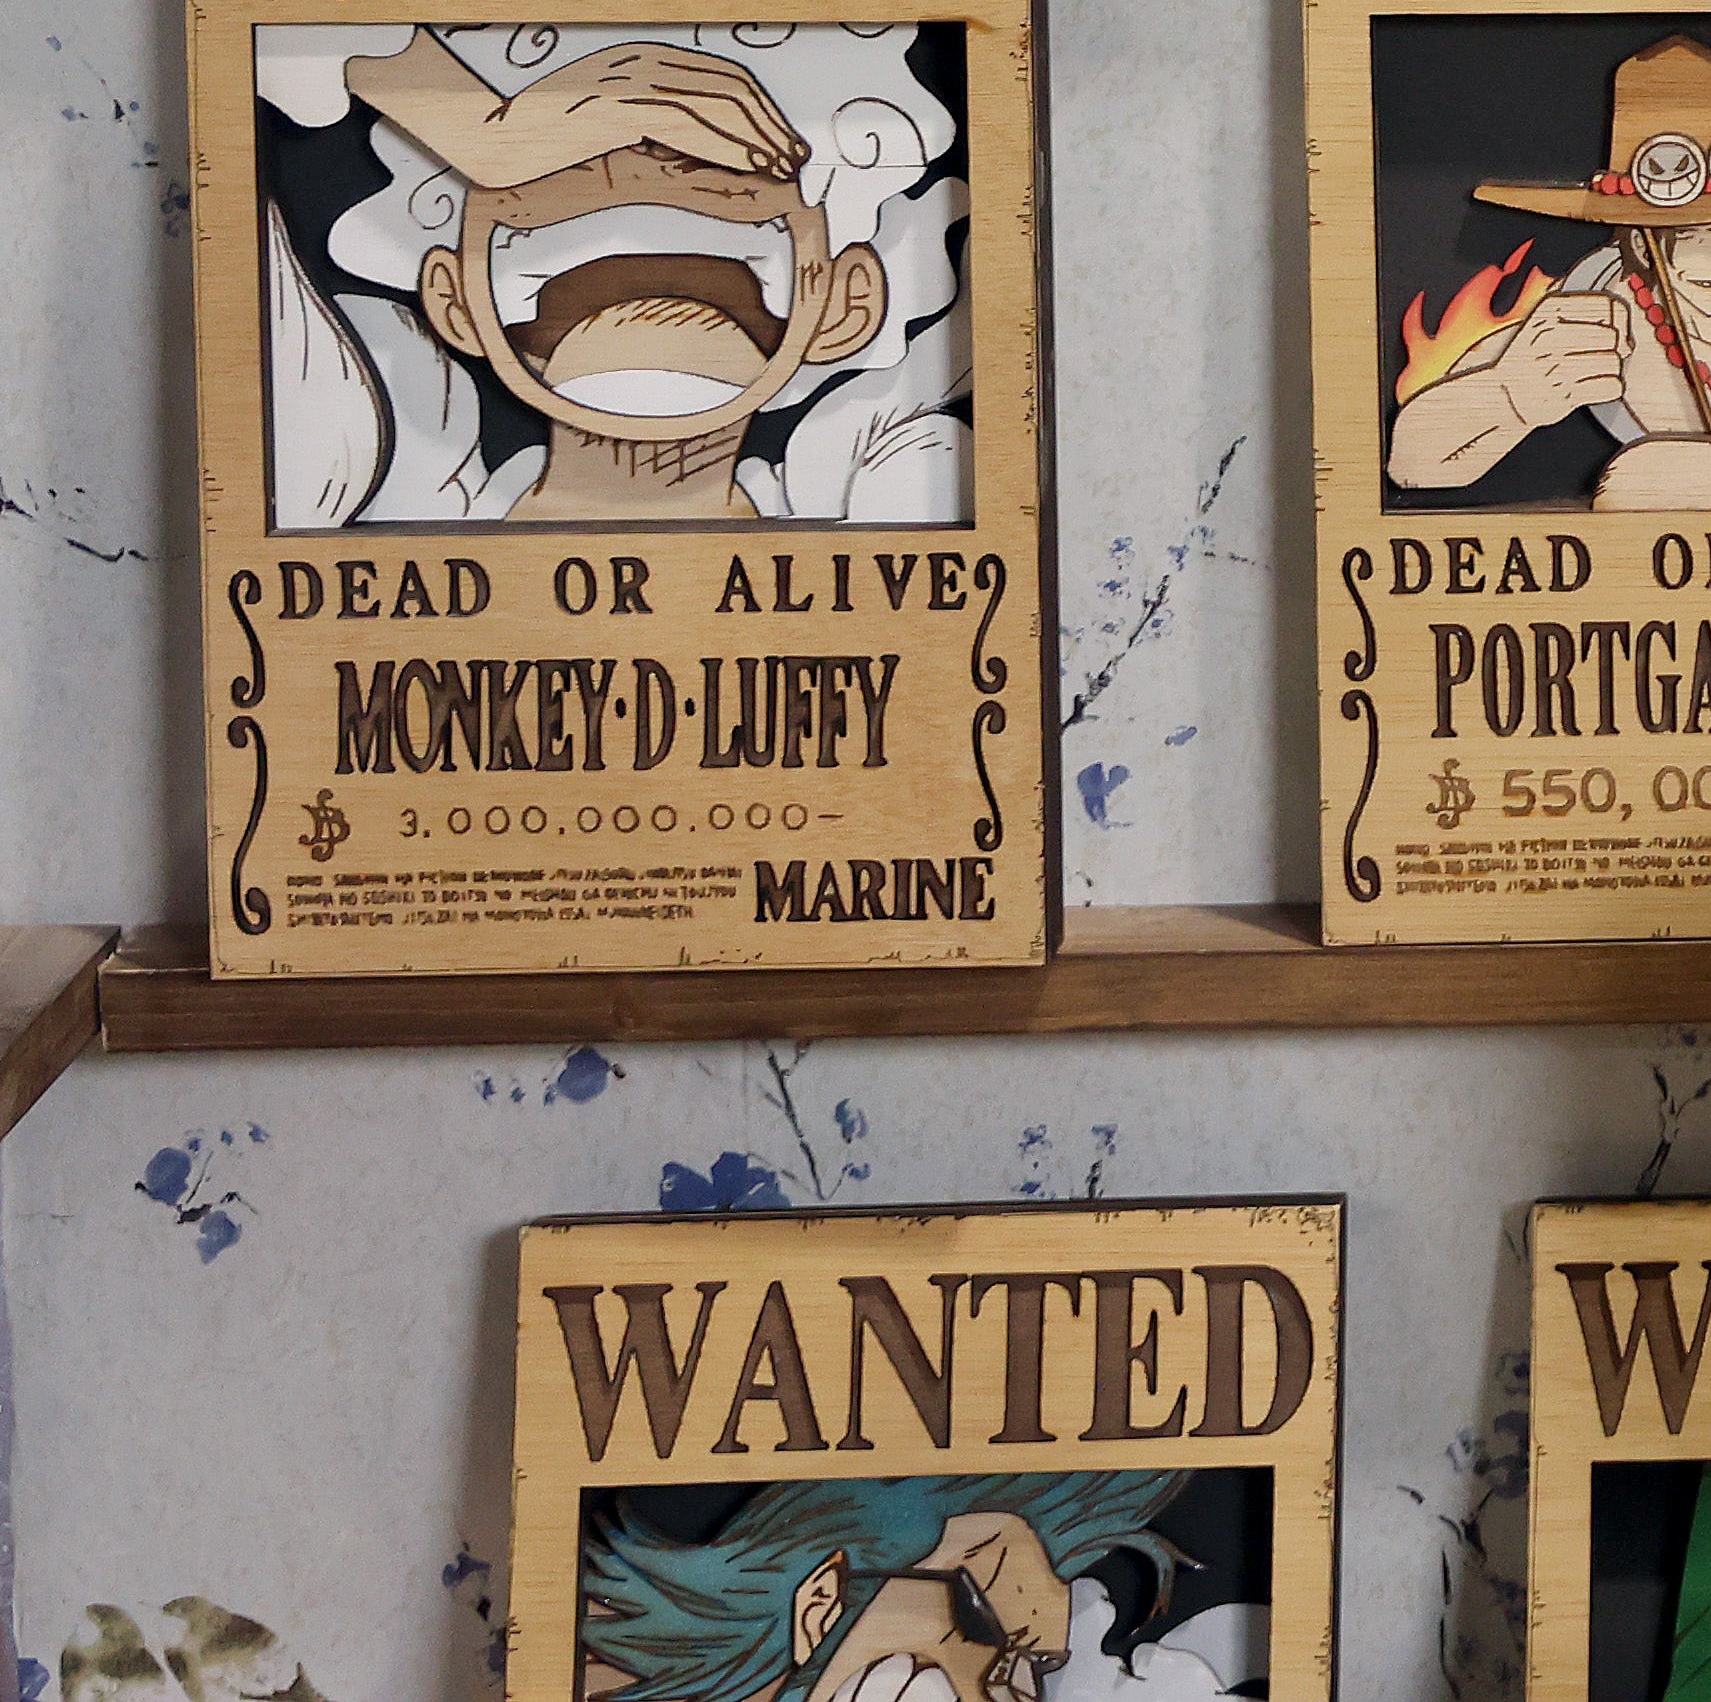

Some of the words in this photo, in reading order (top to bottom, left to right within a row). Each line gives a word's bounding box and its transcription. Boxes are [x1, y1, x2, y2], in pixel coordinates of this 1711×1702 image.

[280, 557, 493, 621] DEAD
[553, 555, 654, 616] OR
[716, 551, 971, 615] ALIVE
[1389, 534, 1594, 597] DEAD
[753, 855, 997, 925] MARINE
[542, 1261, 1318, 1464] WANTED
